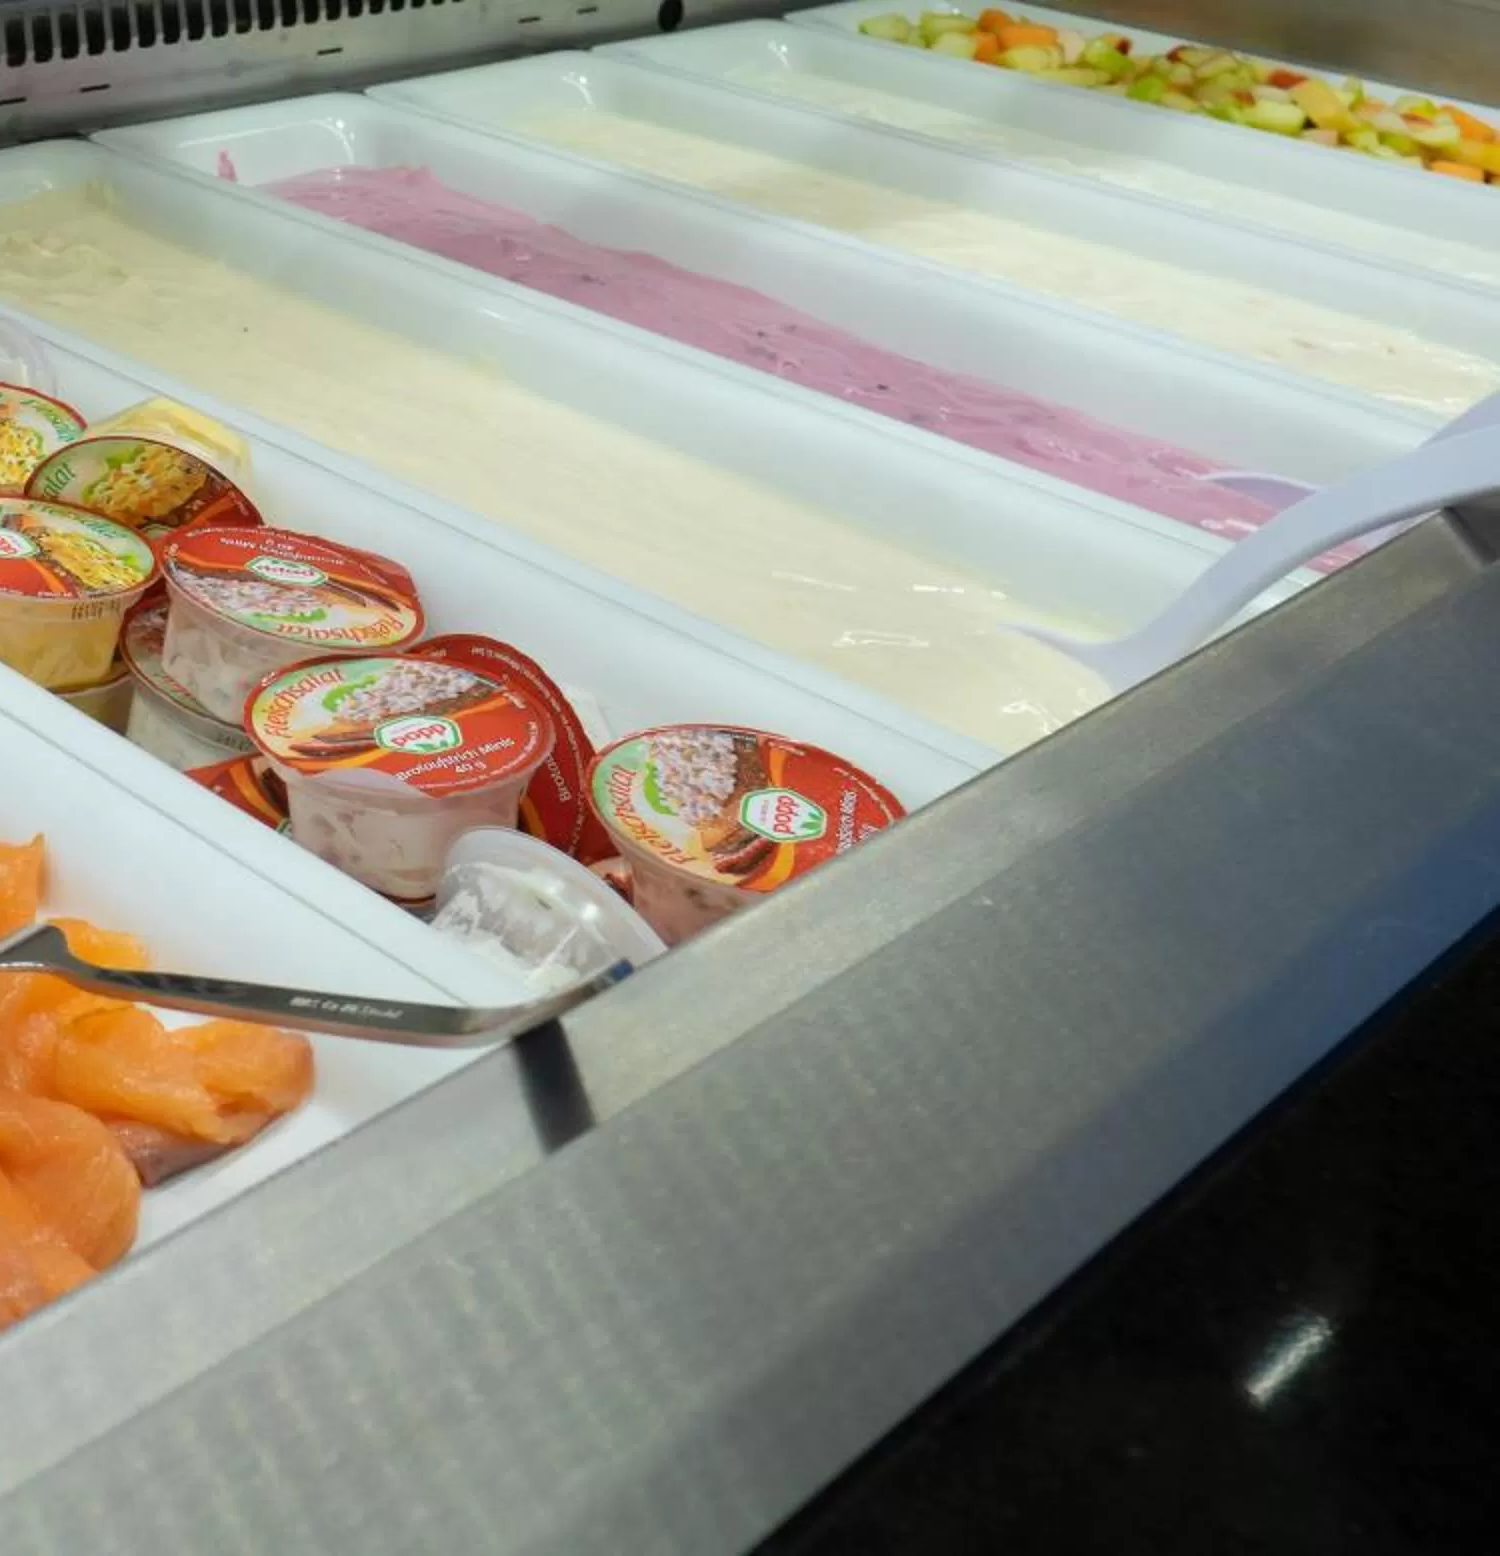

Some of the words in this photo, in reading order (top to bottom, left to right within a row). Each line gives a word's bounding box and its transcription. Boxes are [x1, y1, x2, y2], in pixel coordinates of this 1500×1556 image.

[277, 612, 406, 643] Fleischsalat
[264, 667, 344, 738] Fleischsalat
[390, 722, 447, 747] popp
[607, 763, 697, 865] Fleischsalat
[772, 794, 801, 836] popp
